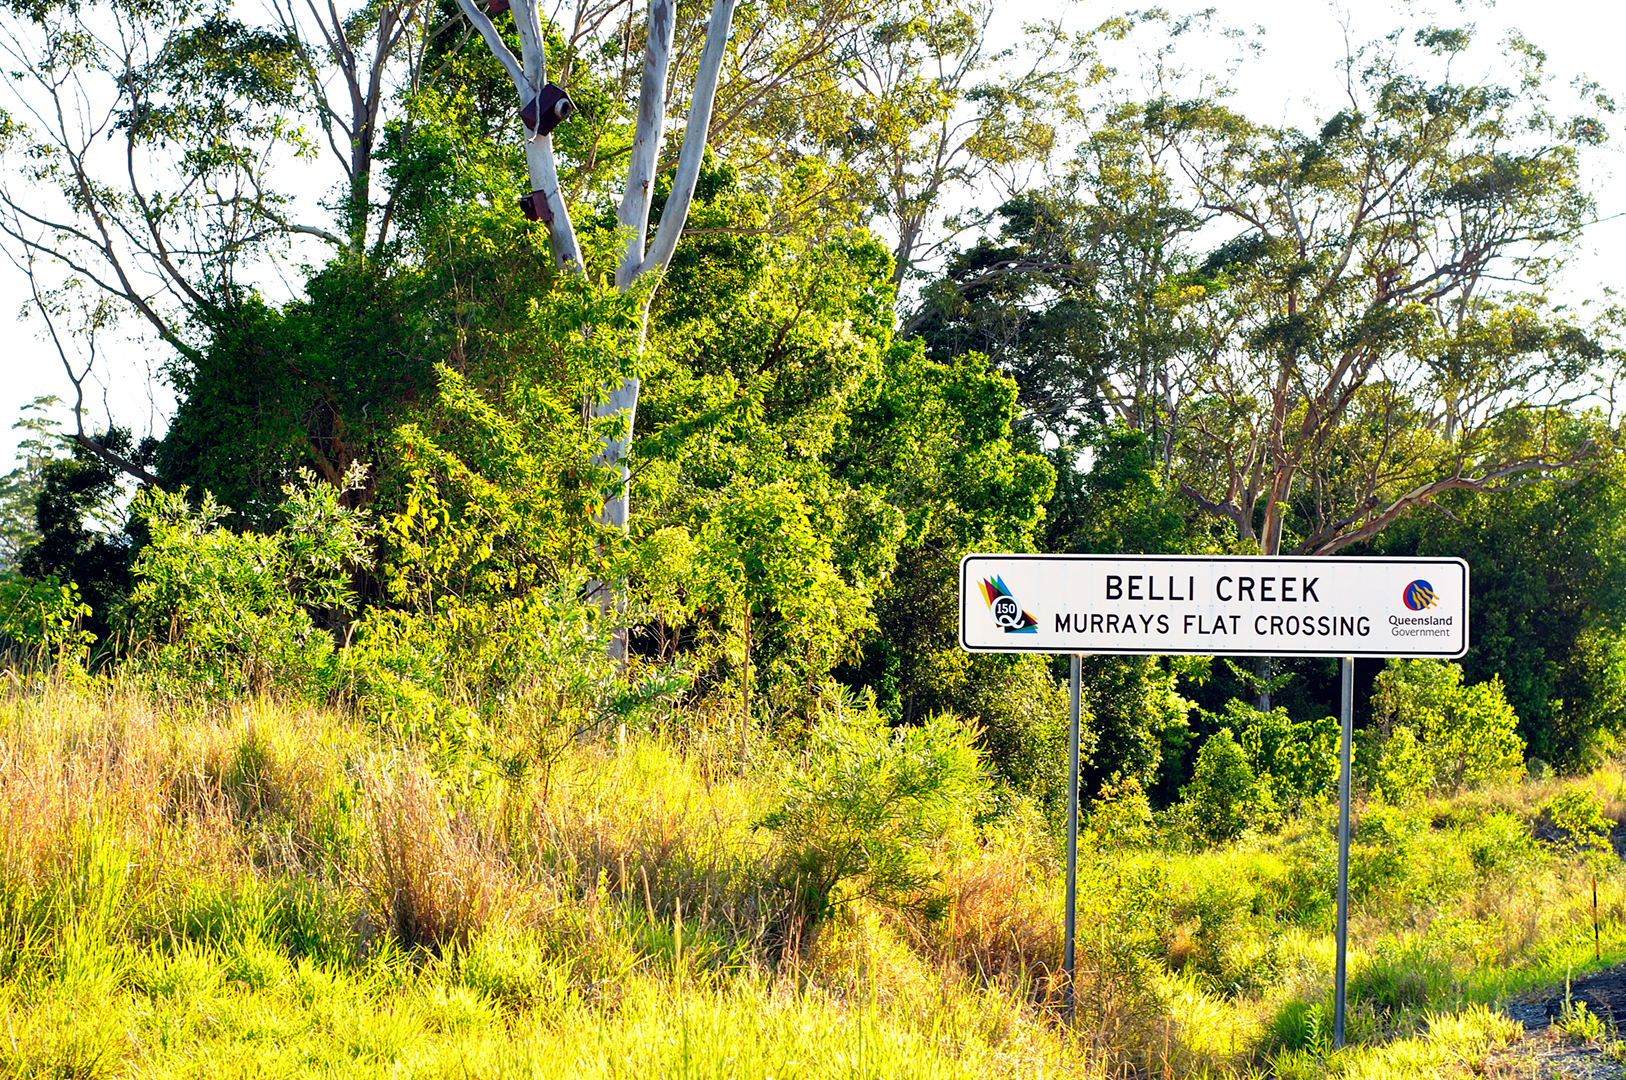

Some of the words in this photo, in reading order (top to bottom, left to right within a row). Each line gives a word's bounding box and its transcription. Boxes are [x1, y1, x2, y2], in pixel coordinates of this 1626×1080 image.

[1106, 575, 1194, 601] BELLI
[1216, 575, 1320, 602] CREEK
[996, 603, 1015, 614] 150
[1055, 613, 1170, 634] MURRAYS
[1183, 614, 1241, 635] FLAT
[1254, 615, 1371, 637] CROSSING
[1388, 614, 1453, 627] Queensland
[1391, 626, 1450, 637] Government
